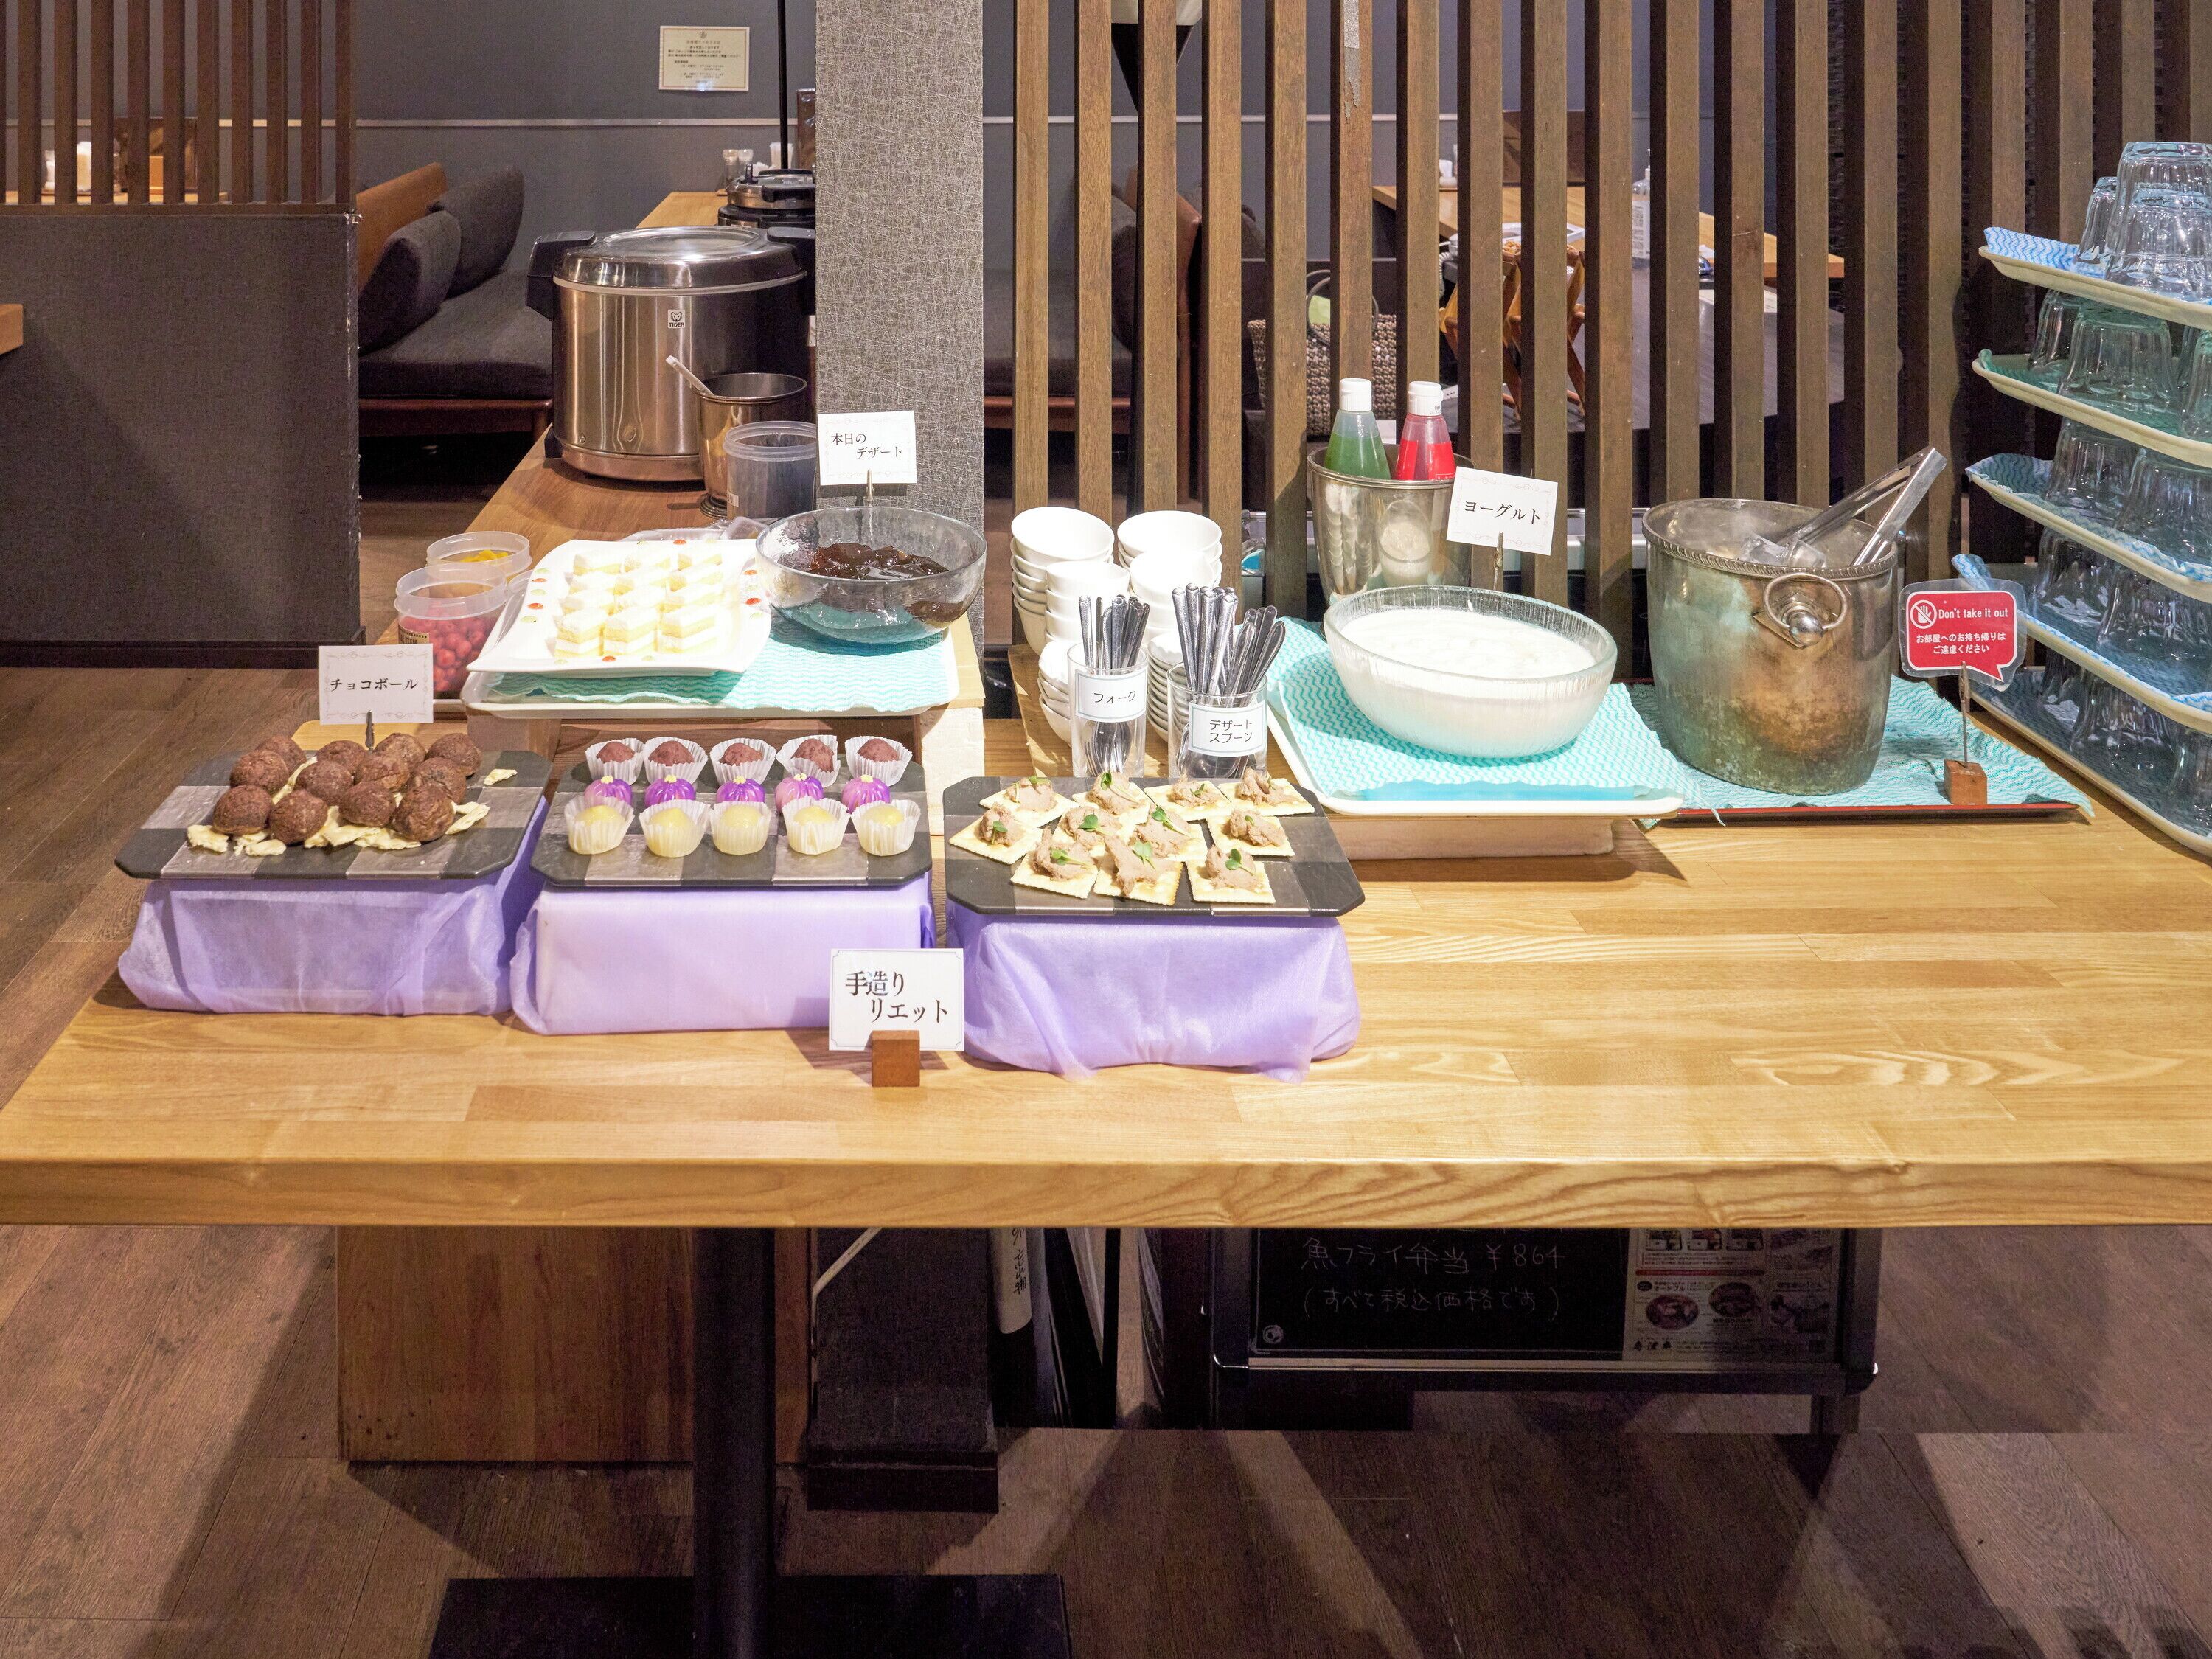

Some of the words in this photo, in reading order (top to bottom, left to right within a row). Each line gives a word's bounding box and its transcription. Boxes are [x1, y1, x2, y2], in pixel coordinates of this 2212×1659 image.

[831, 433, 866, 445] 本日の
[857, 446, 902, 459] デザート
[1464, 501, 1540, 524] ヨーグルト
[1938, 608, 1960, 619] Don't
[1964, 608, 1982, 618] take
[1985, 608, 1991, 617] it
[1994, 608, 2008, 617] out
[1916, 632, 2006, 643] お部屋へのお持ち帰りは
[1933, 644, 1990, 655] ご遠慮ください
[330, 678, 418, 692] チョコボール
[1093, 691, 1136, 704] フォーク
[1209, 719, 1253, 731] デザート
[1209, 732, 1253, 744] スプーン
[846, 970, 905, 996] 手造り
[871, 998, 947, 1023] リエット
[1301, 1237, 1470, 1274] 魚フライ弁当
